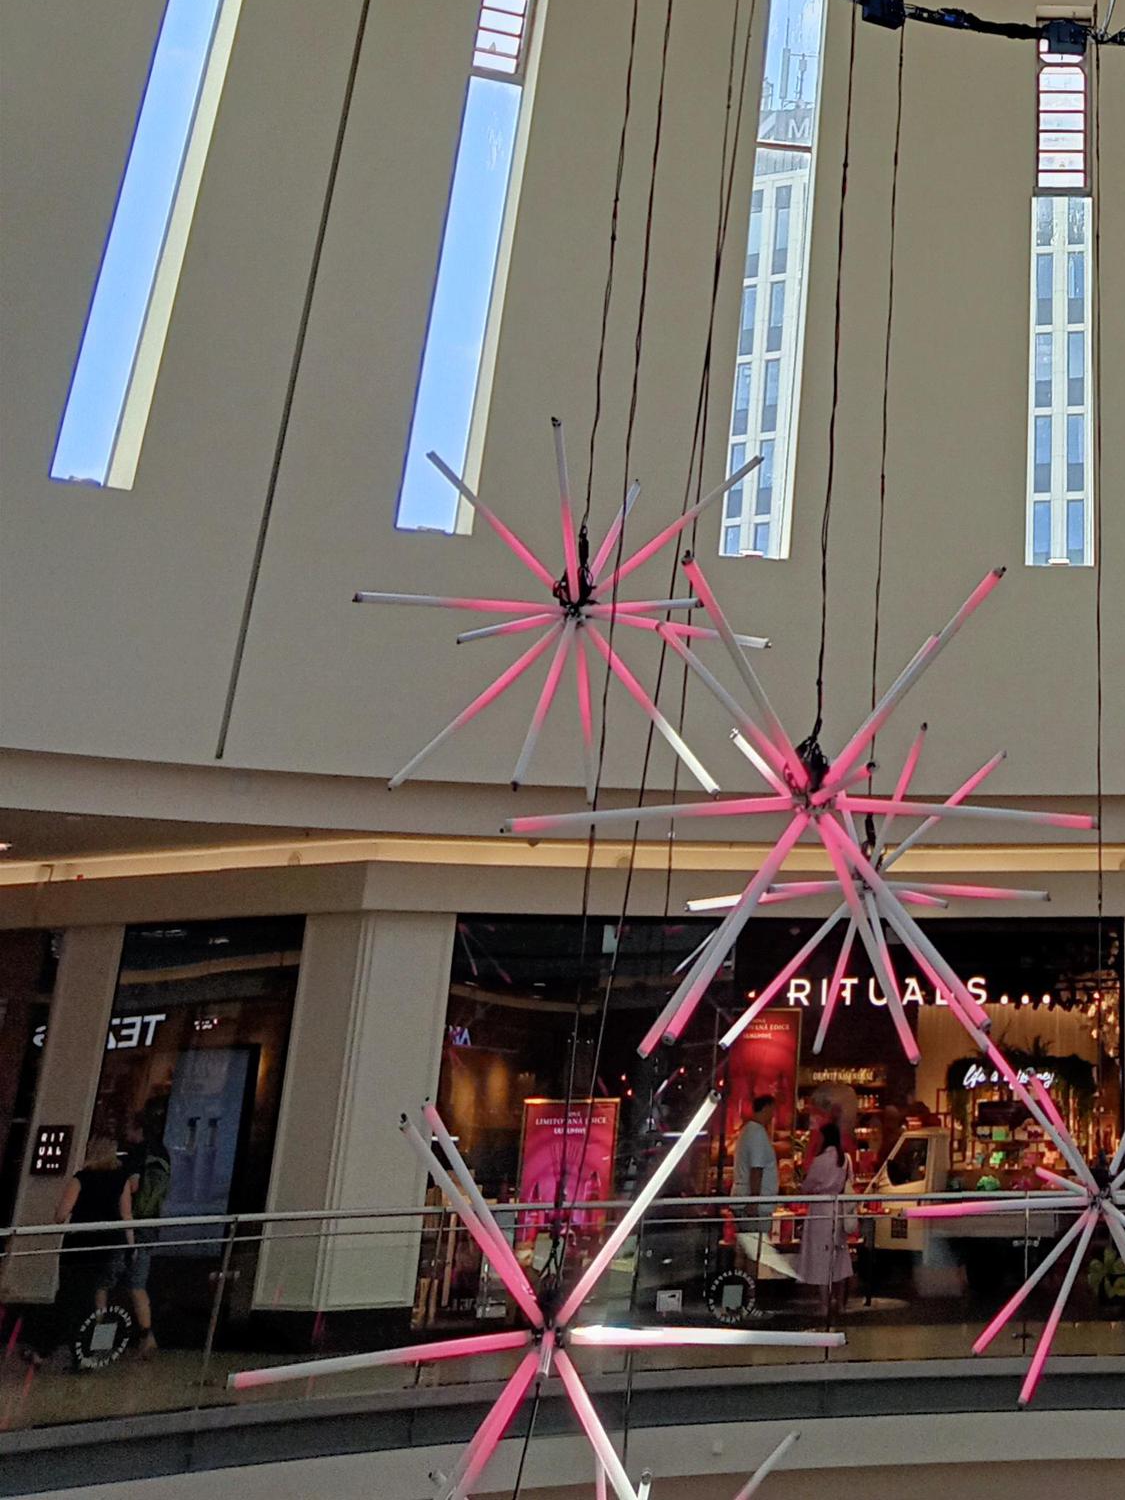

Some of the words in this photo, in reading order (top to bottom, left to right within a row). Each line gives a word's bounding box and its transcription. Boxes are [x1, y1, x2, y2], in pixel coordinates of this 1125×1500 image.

[788, 118, 810, 139] M
[41, 1132, 65, 1142] RIT
[38, 1146, 62, 1156] UAL
